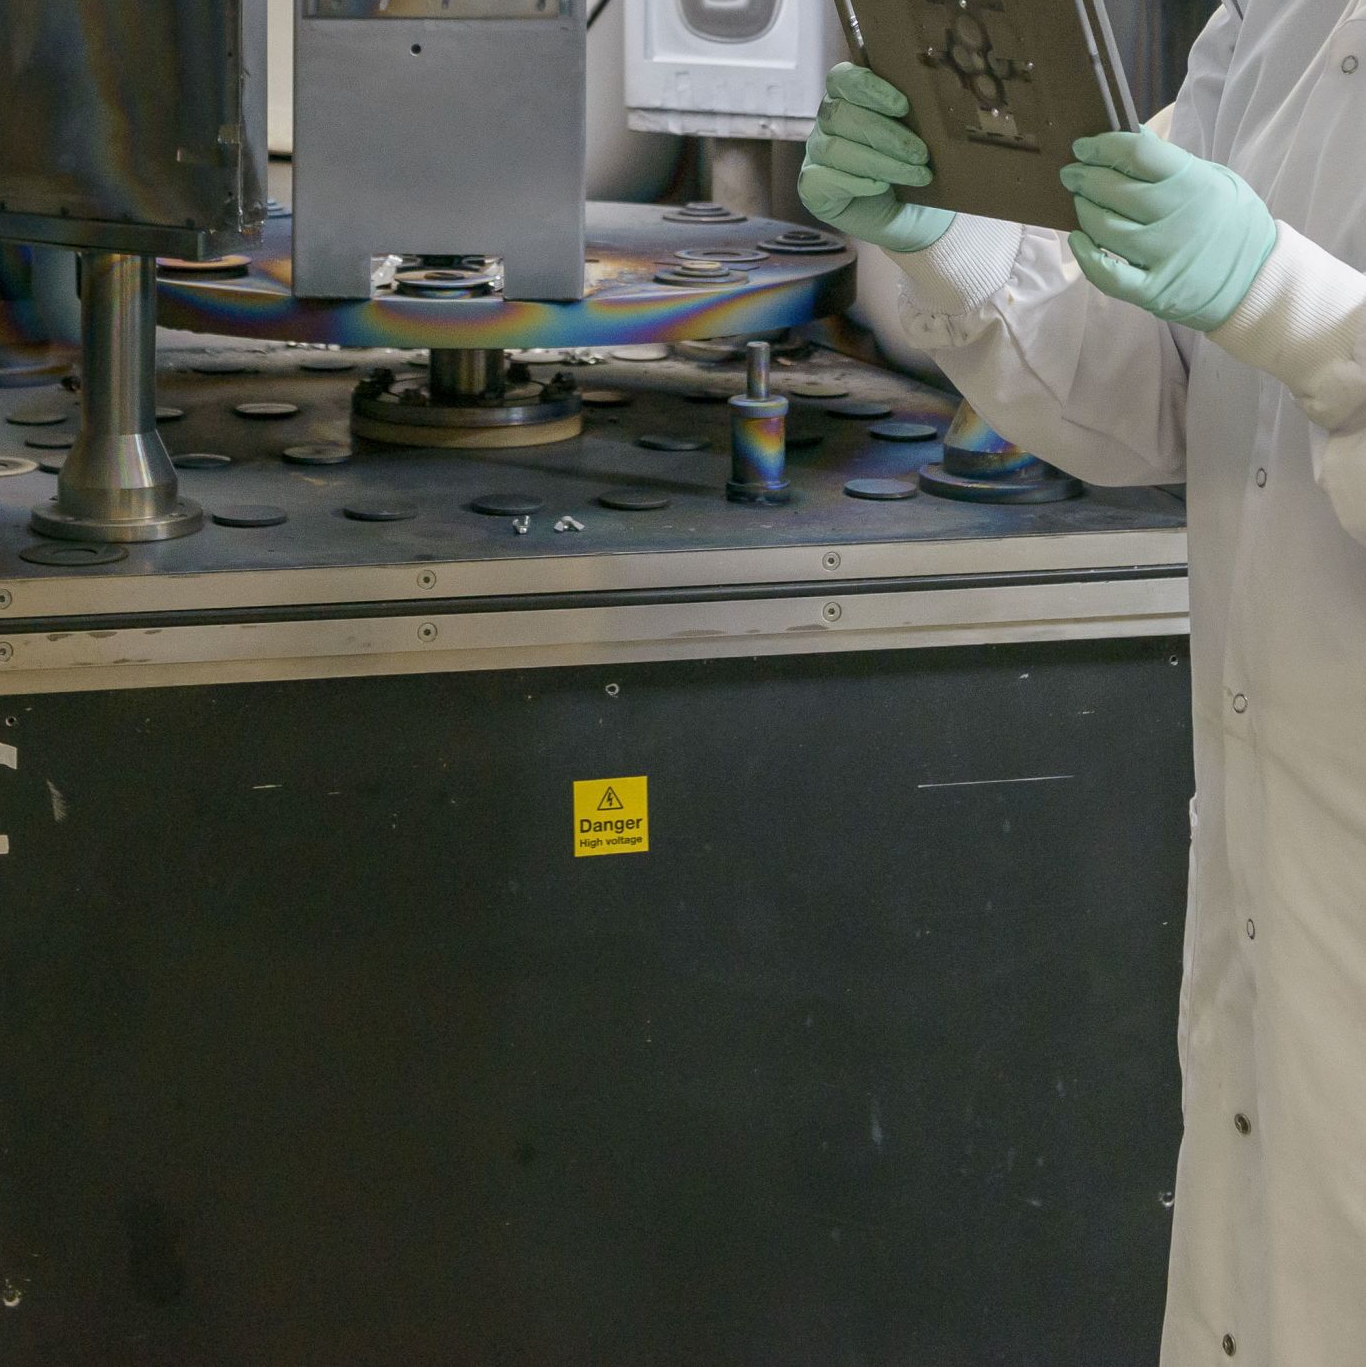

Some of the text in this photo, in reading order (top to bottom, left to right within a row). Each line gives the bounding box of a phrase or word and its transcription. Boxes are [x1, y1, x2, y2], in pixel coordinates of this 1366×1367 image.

[580, 818, 643, 834] Danger
[580, 835, 643, 849] High voltage
